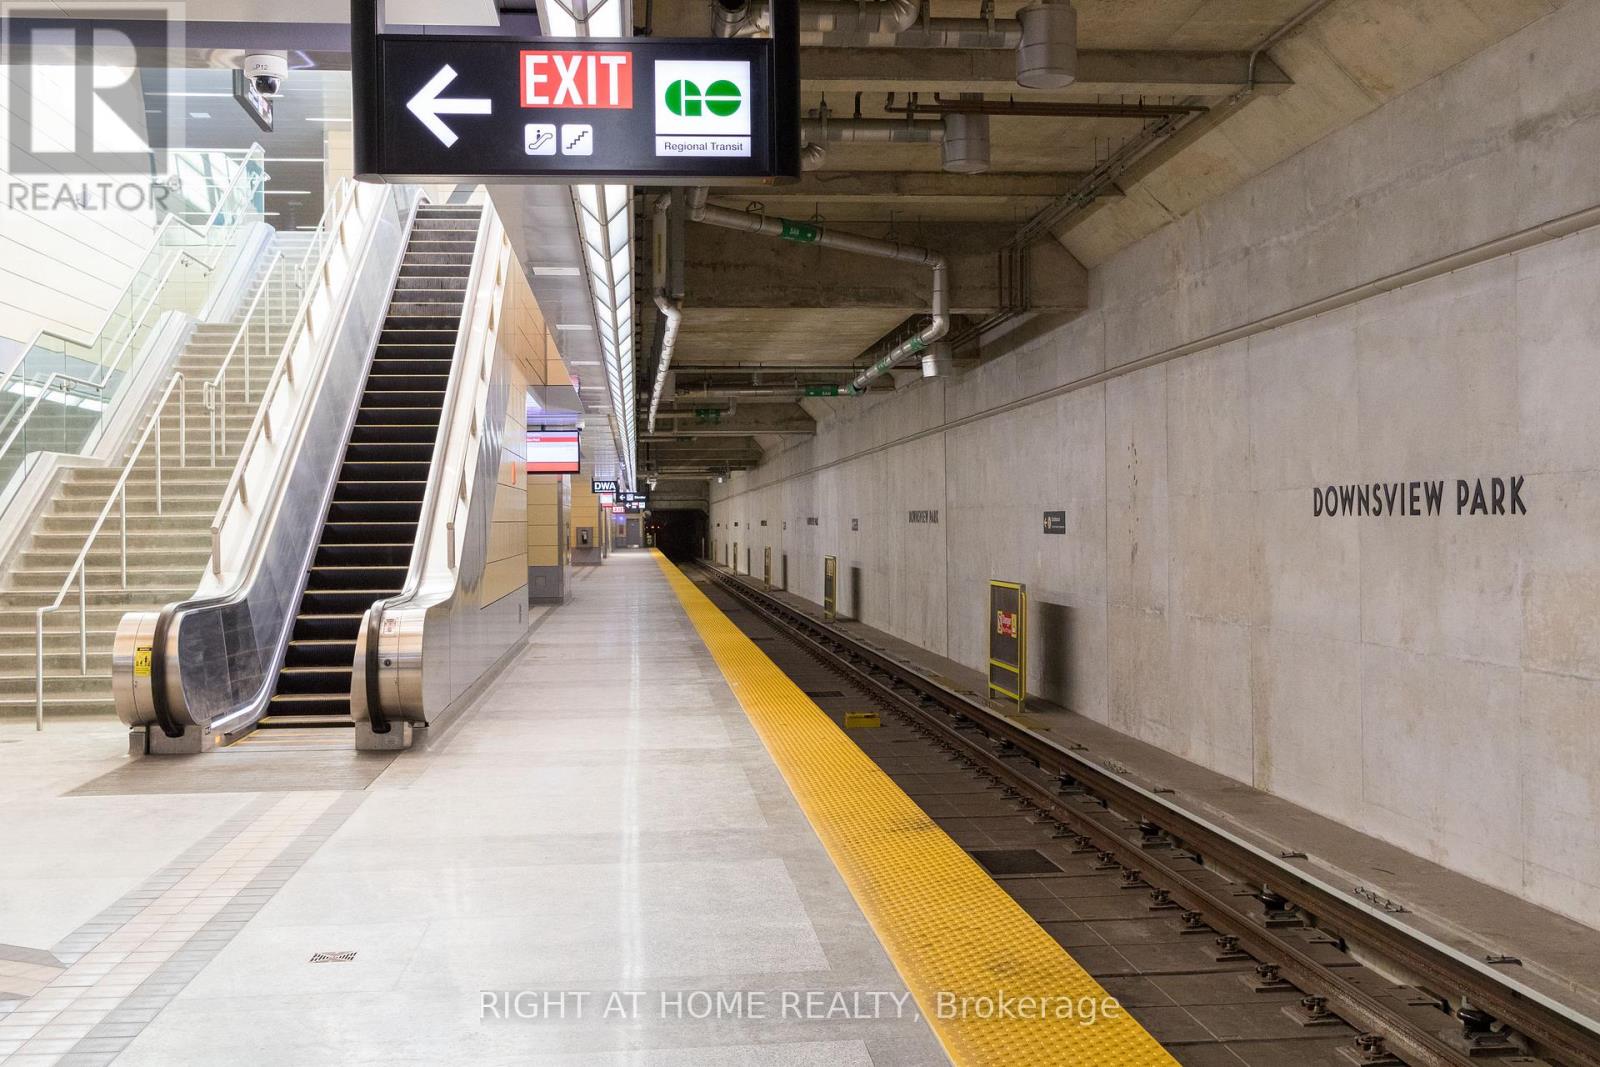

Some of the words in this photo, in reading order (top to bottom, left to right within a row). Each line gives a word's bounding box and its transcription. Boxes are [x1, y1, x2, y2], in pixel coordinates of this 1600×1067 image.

[525, 54, 627, 106] EXIT
[664, 141, 708, 153] Regional
[711, 142, 743, 152] Transit
[594, 482, 616, 490] DWA
[1313, 480, 1444, 517] DOWNSVIEW
[1456, 475, 1527, 516] PARK
